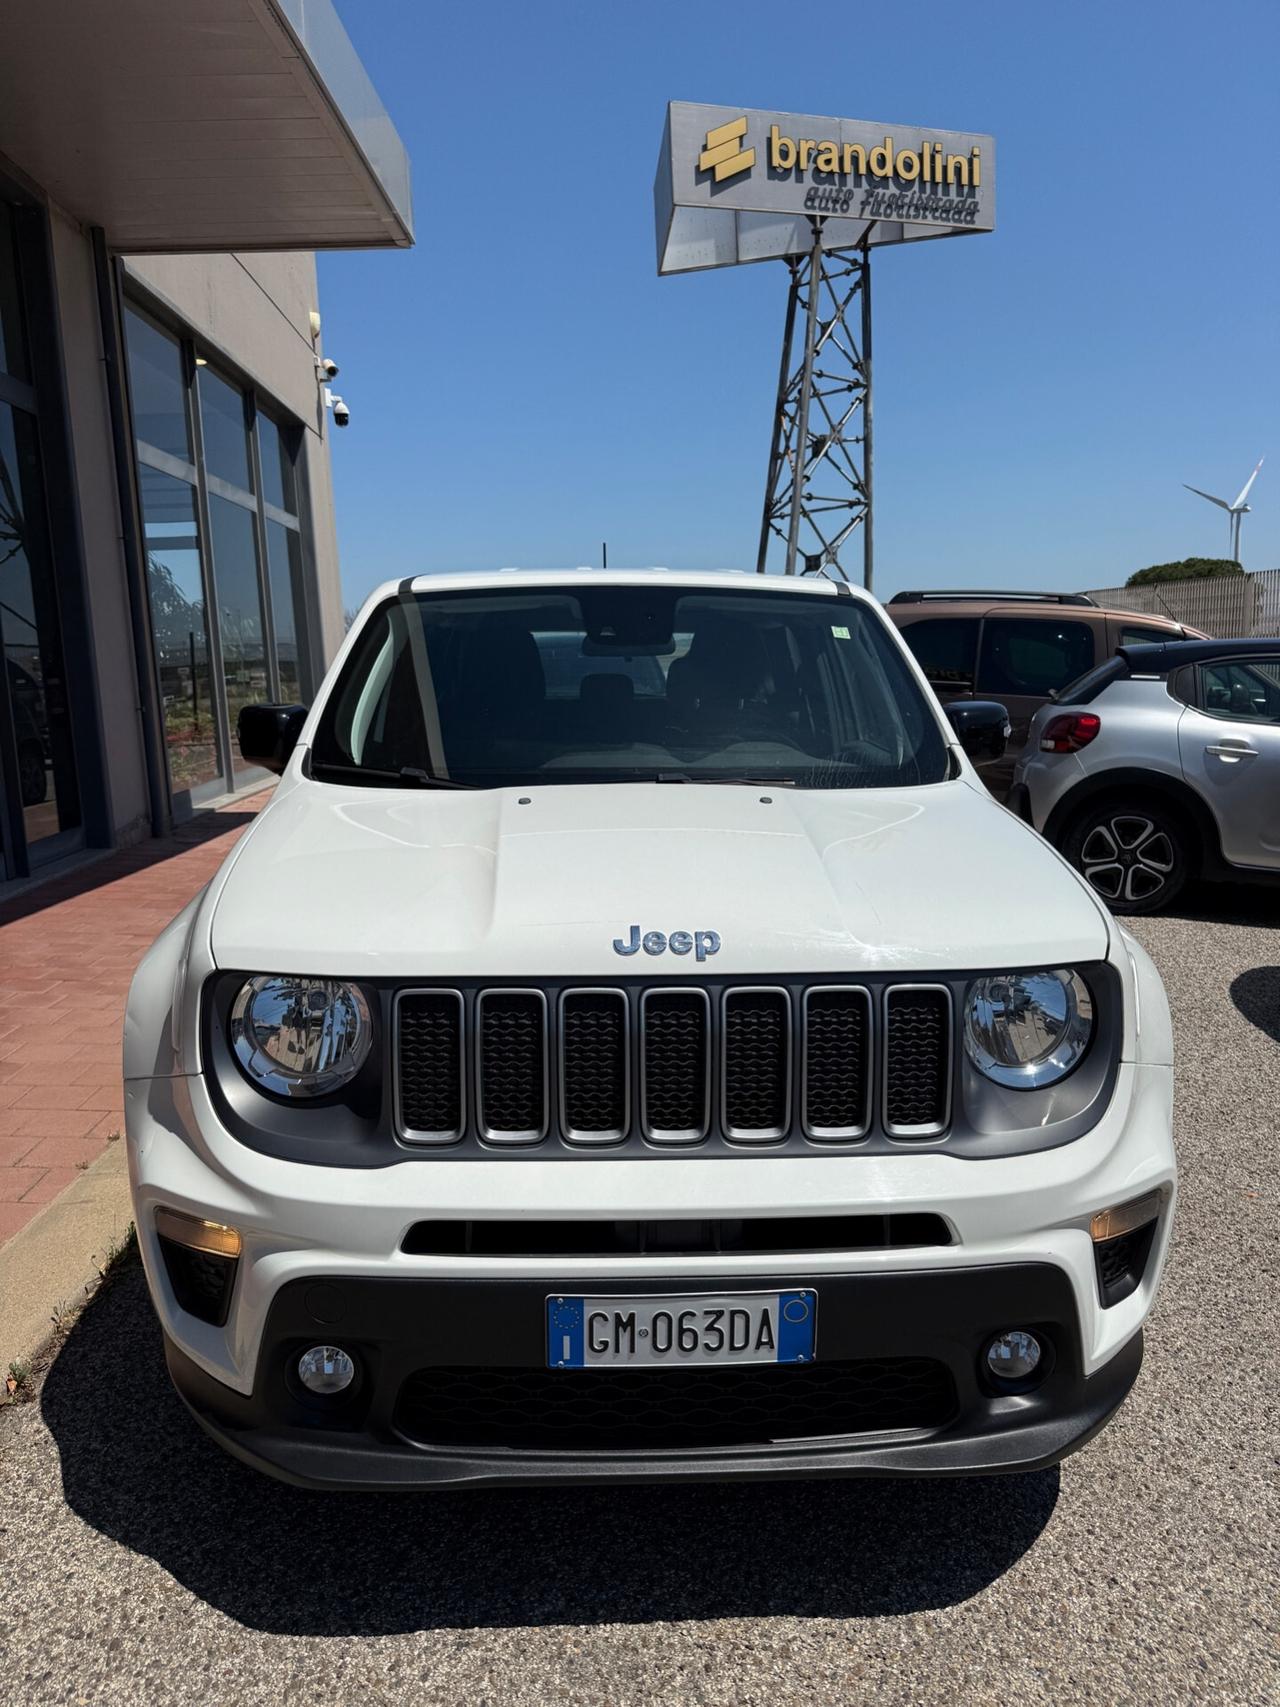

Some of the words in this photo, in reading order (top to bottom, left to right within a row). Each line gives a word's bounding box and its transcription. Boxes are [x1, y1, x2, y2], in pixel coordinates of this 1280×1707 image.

[770, 124, 981, 187] brandolini
[804, 187, 854, 213] auto
[612, 925, 721, 962] Jeep
